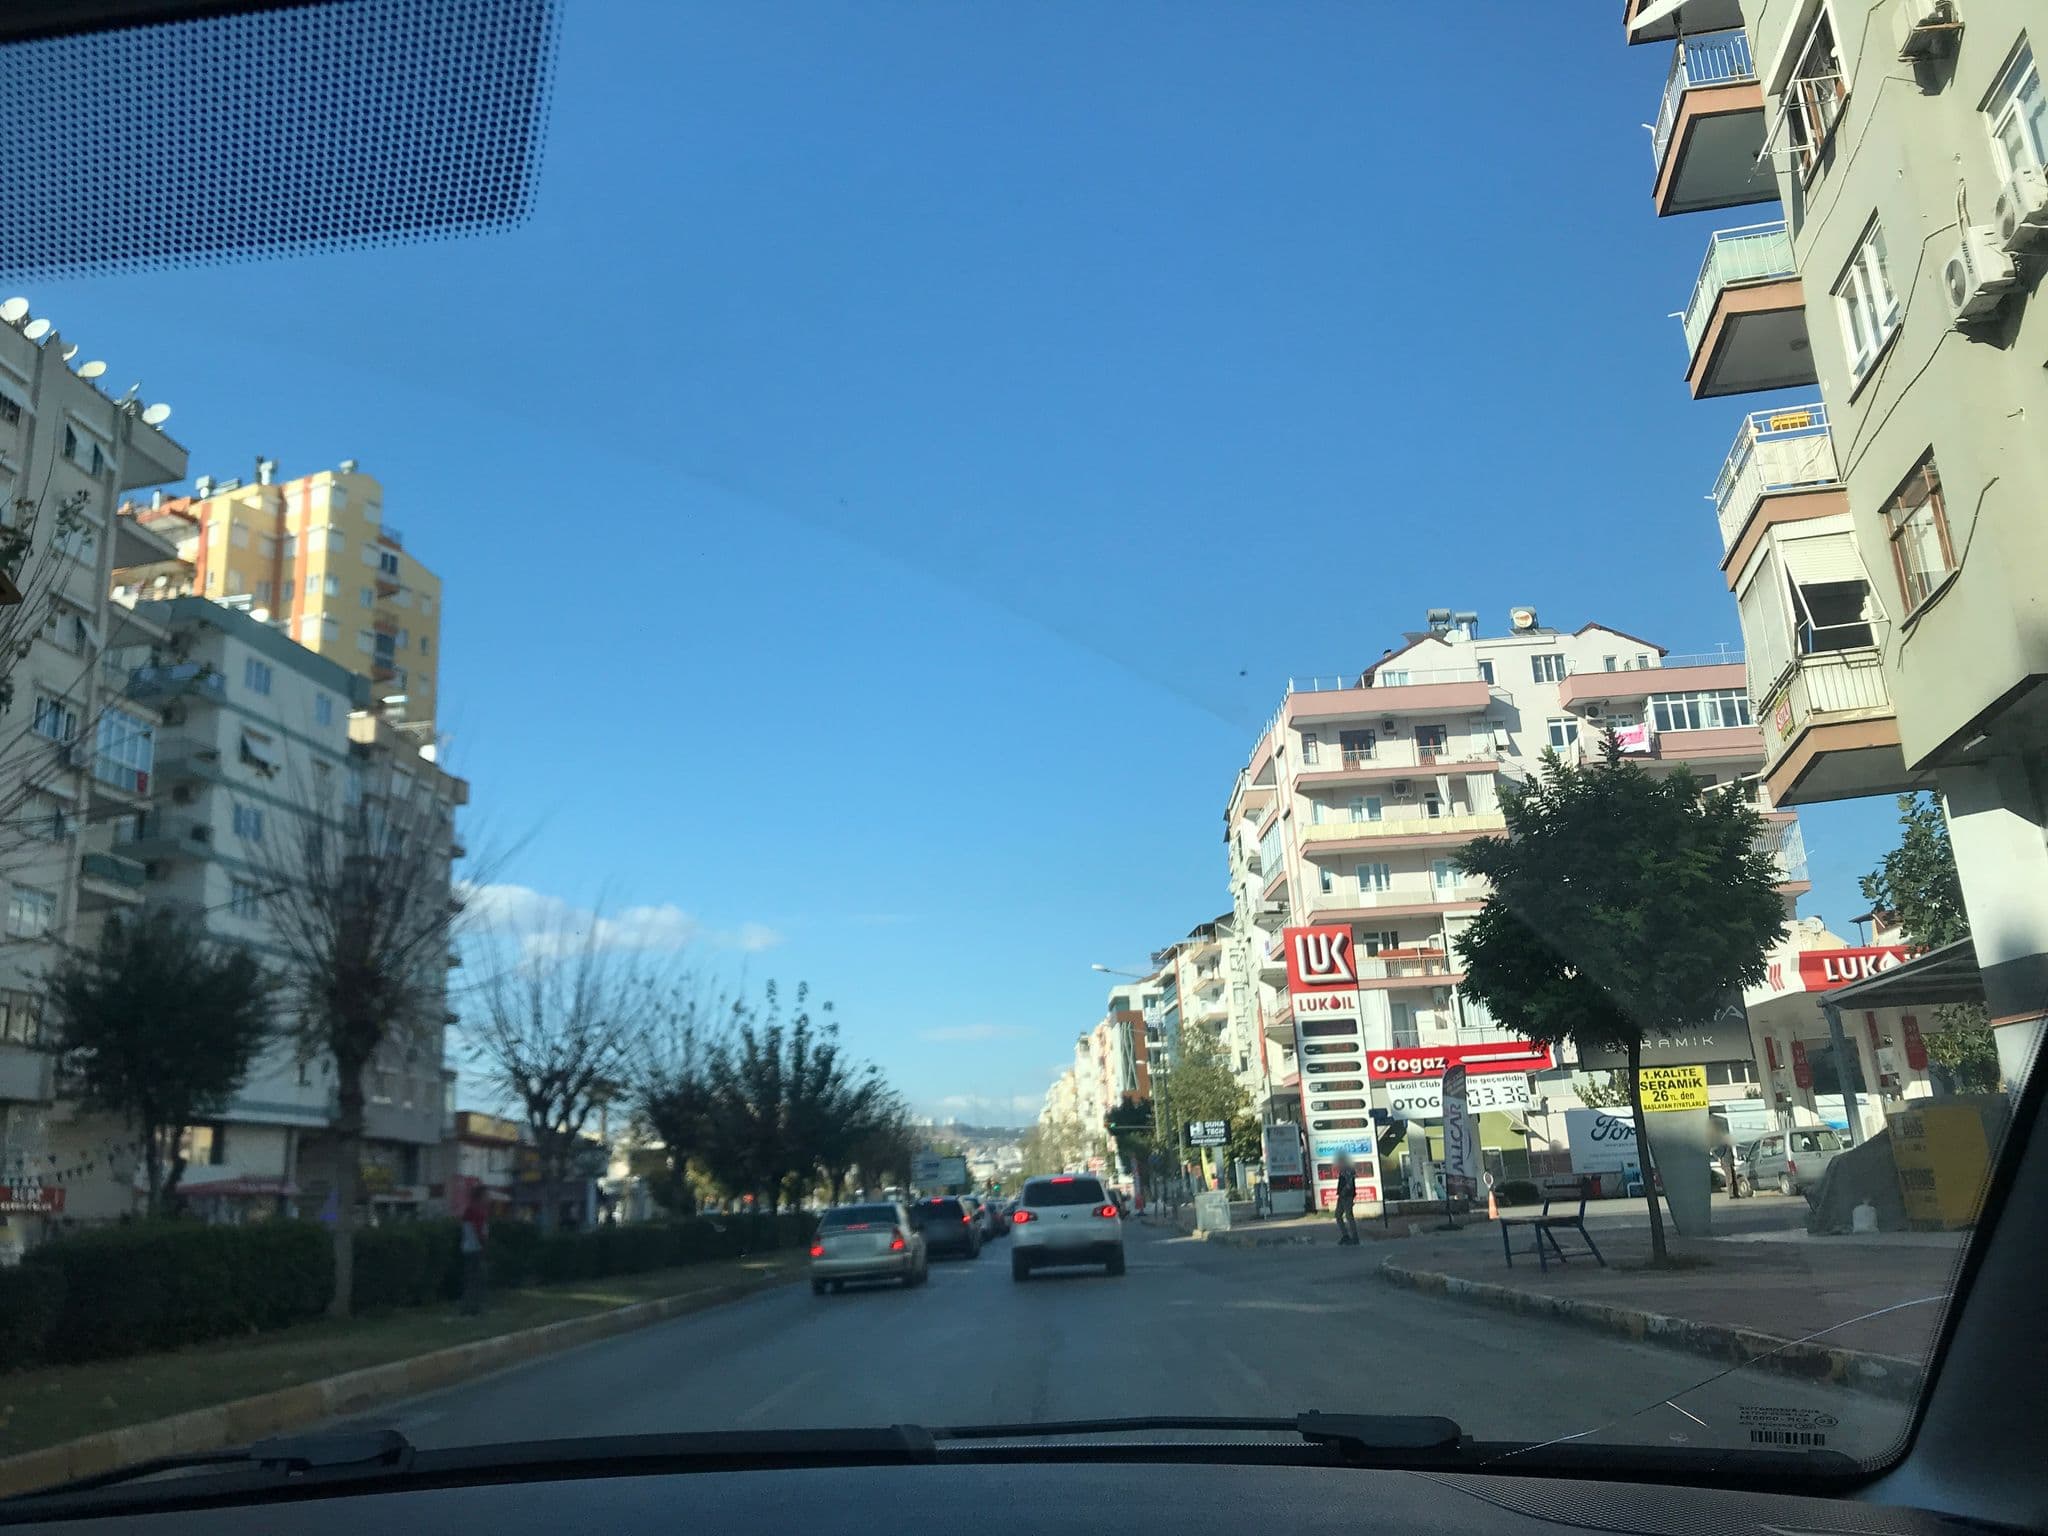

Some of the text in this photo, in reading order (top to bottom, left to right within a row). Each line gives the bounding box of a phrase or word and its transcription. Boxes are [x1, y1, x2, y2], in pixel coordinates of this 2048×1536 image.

[1823, 950, 1921, 981] LUKO
[1299, 995, 1355, 1012] LUKOIL
[1373, 1056, 1446, 1073] Otogaz
[1390, 1081, 1417, 1091] Lukoil
[1420, 1080, 1441, 1089] Club
[1393, 1096, 1441, 1111] OTOG
[1653, 1091, 1669, 1103] 26
[1680, 1090, 1695, 1100] den
[1591, 1114, 1638, 1142] For
